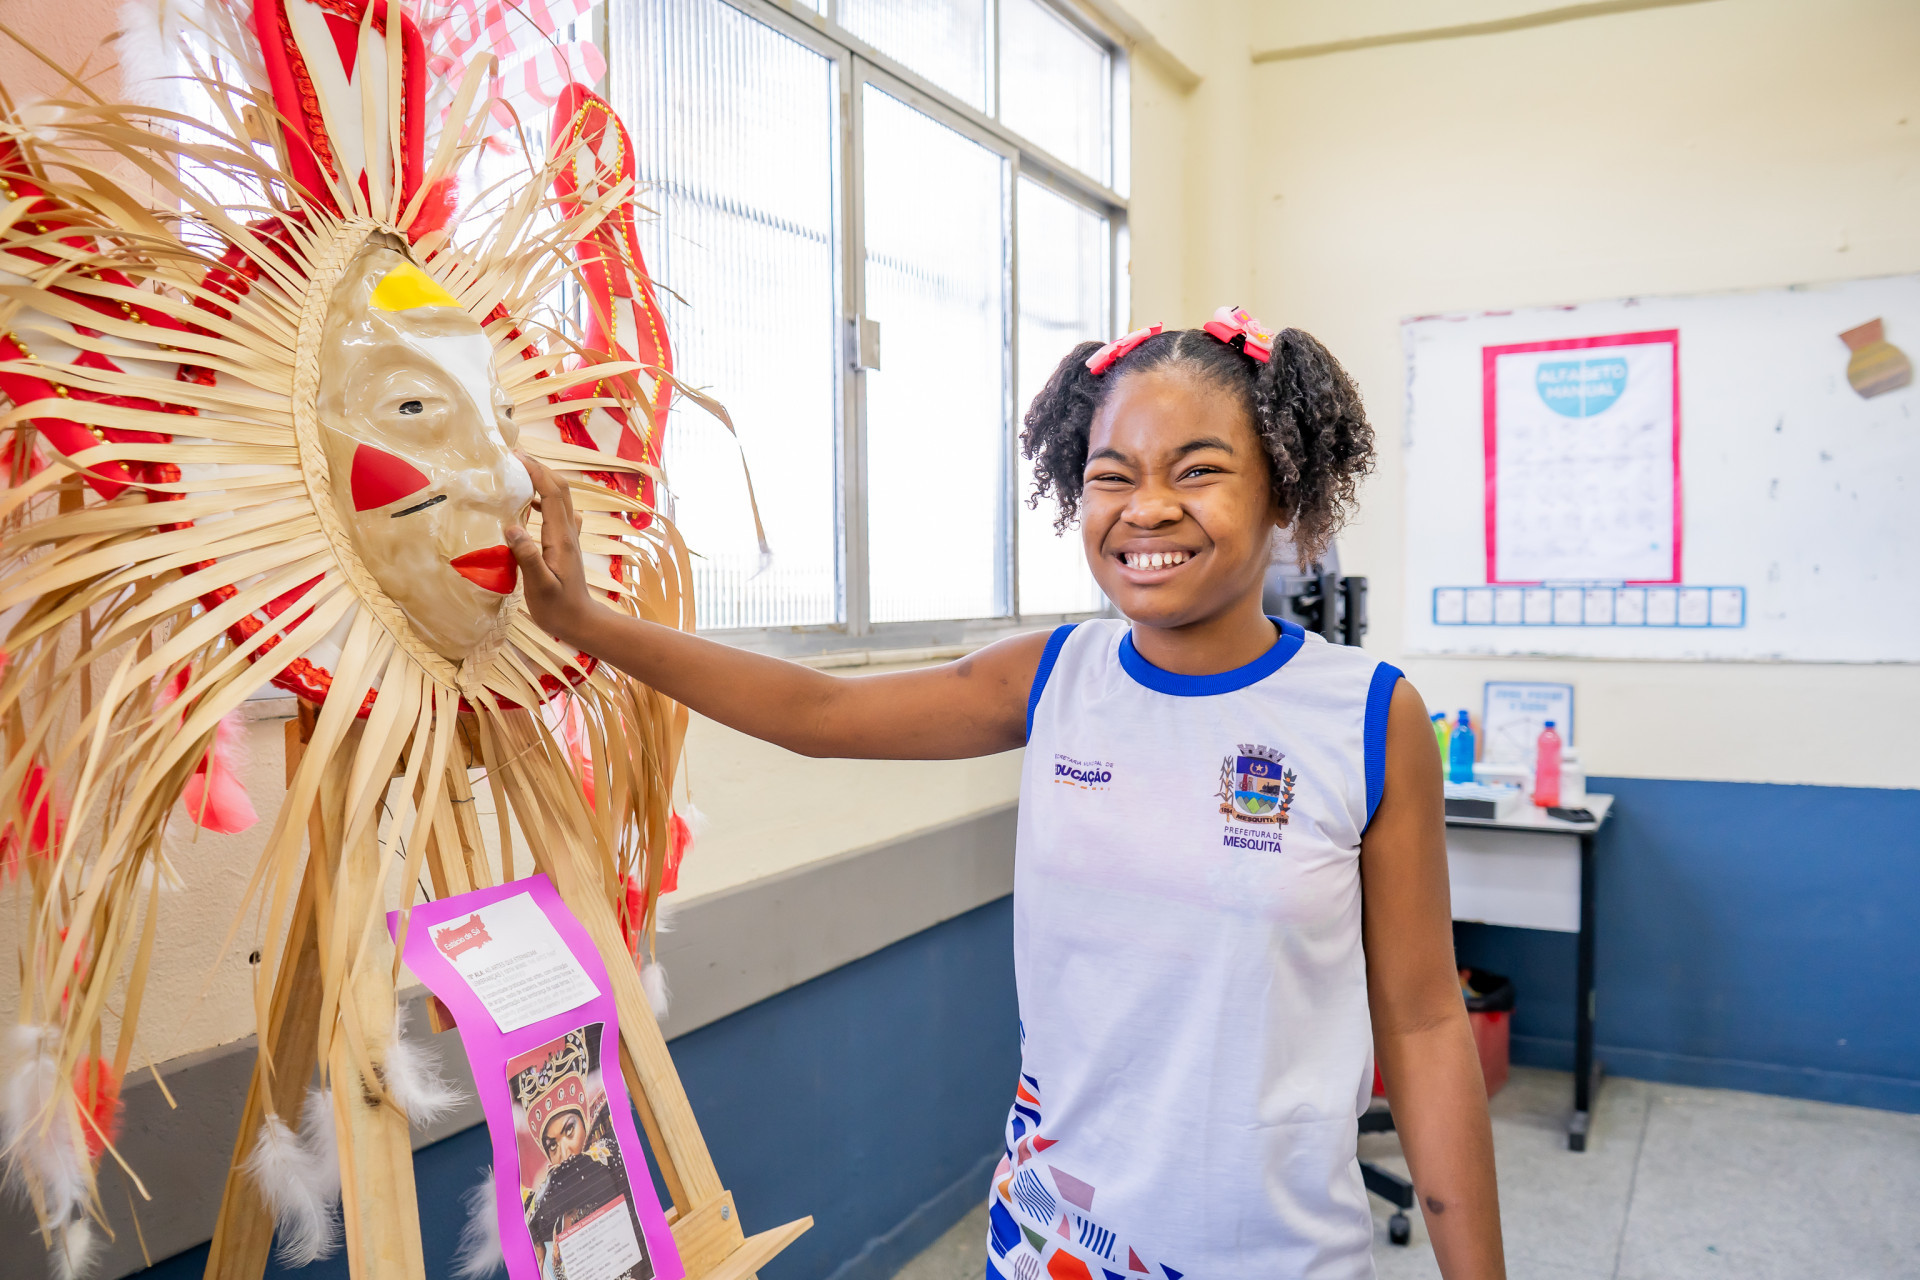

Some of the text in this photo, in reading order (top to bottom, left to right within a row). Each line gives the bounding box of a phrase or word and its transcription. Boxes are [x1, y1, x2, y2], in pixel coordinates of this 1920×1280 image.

[1540, 364, 1625, 383] ALFABETO
[1546, 381, 1617, 400] MANUAL
[1224, 825, 1283, 841] PREFEITURA DE
[1223, 835, 1282, 854] MESQUITA
[464, 932, 472, 940] de
